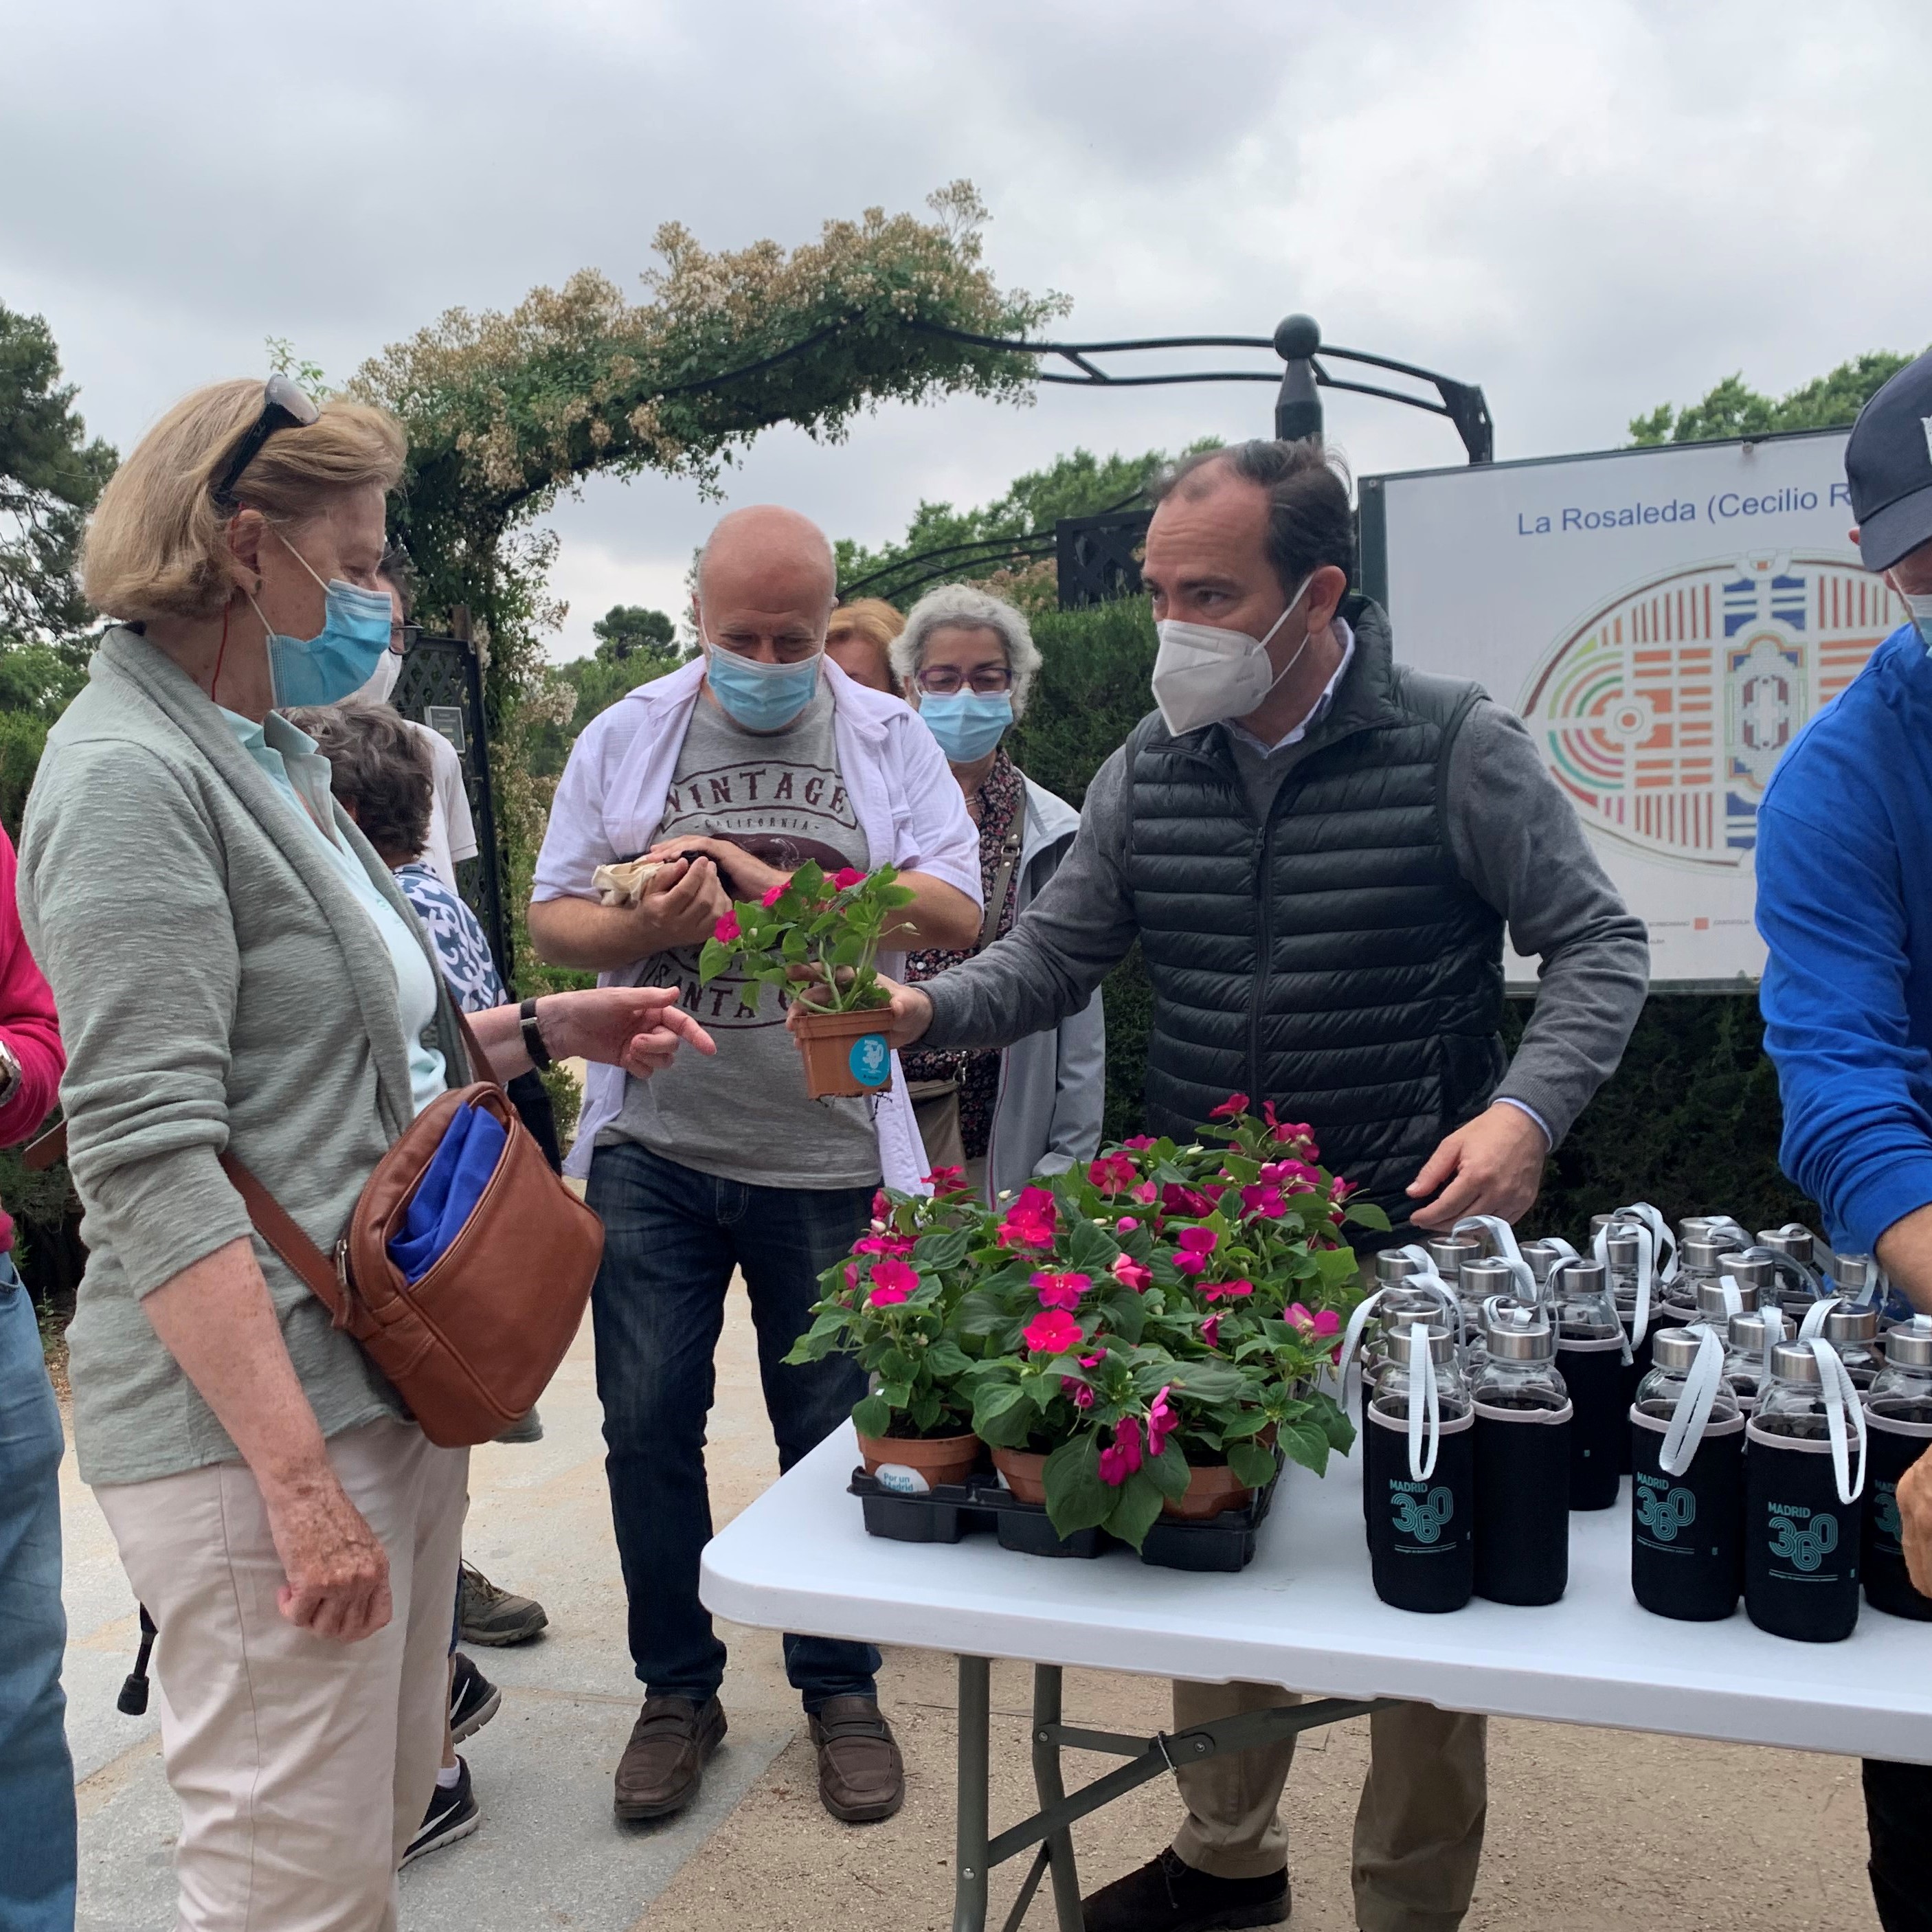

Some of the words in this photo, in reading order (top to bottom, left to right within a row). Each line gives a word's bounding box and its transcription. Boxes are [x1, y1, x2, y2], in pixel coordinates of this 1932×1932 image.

[1518, 513, 1551, 536] La
[1562, 499, 1696, 531] Rosaleda
[1707, 488, 1819, 525] (Cecilio
[1830, 482, 1853, 507] R
[665, 768, 849, 814] VINTAGE
[884, 1472, 897, 1482] Por
[1389, 1478, 1428, 1493] MADRID
[1637, 1471, 1670, 1491] MADRID
[1874, 1479, 1896, 1493] MAD
[1390, 1486, 1454, 1544] 360
[1636, 1485, 1696, 1542] 360
[1767, 1501, 1811, 1519] MADRID
[1768, 1513, 1839, 1572] 360
